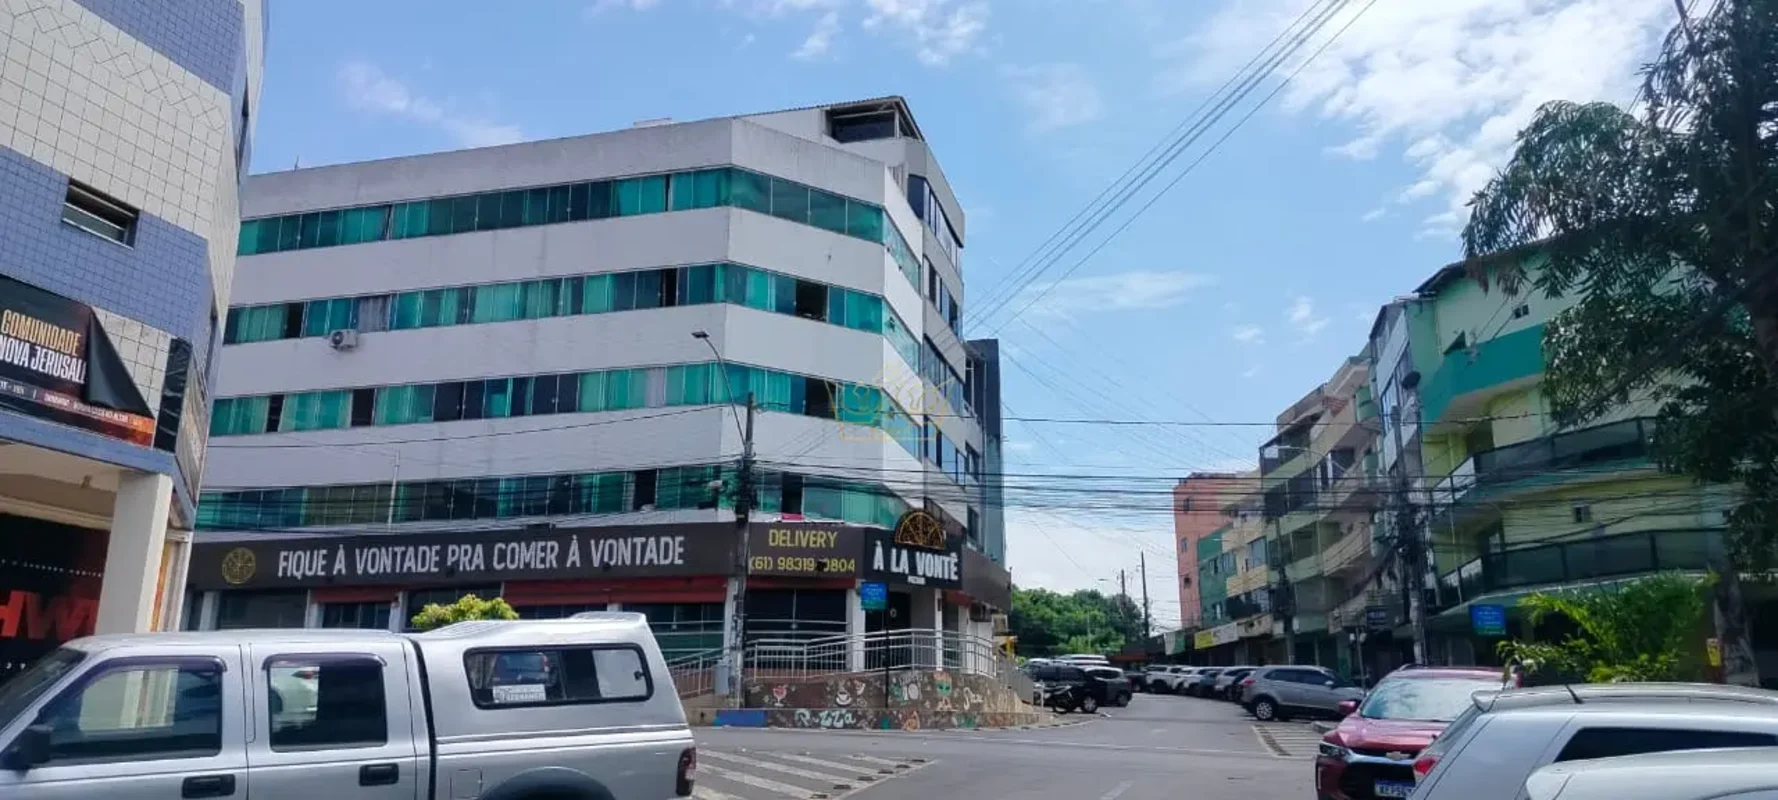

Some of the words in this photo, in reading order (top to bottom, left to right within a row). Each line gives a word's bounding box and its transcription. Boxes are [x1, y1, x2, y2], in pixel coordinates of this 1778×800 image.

[1, 309, 83, 357] COMUNIDADE
[278, 549, 328, 580] FIQUE
[332, 543, 346, 575] À
[355, 545, 441, 575] VONTADE
[447, 543, 485, 573] PRA
[493, 540, 559, 570] COMER
[566, 534, 581, 568] À
[590, 536, 685, 568] VONTADE
[768, 529, 839, 549] DELIVERY
[749, 556, 774, 571] (61)
[873, 540, 885, 571] À
[890, 548, 909, 575] LA
[915, 551, 959, 581] VONTÊ
